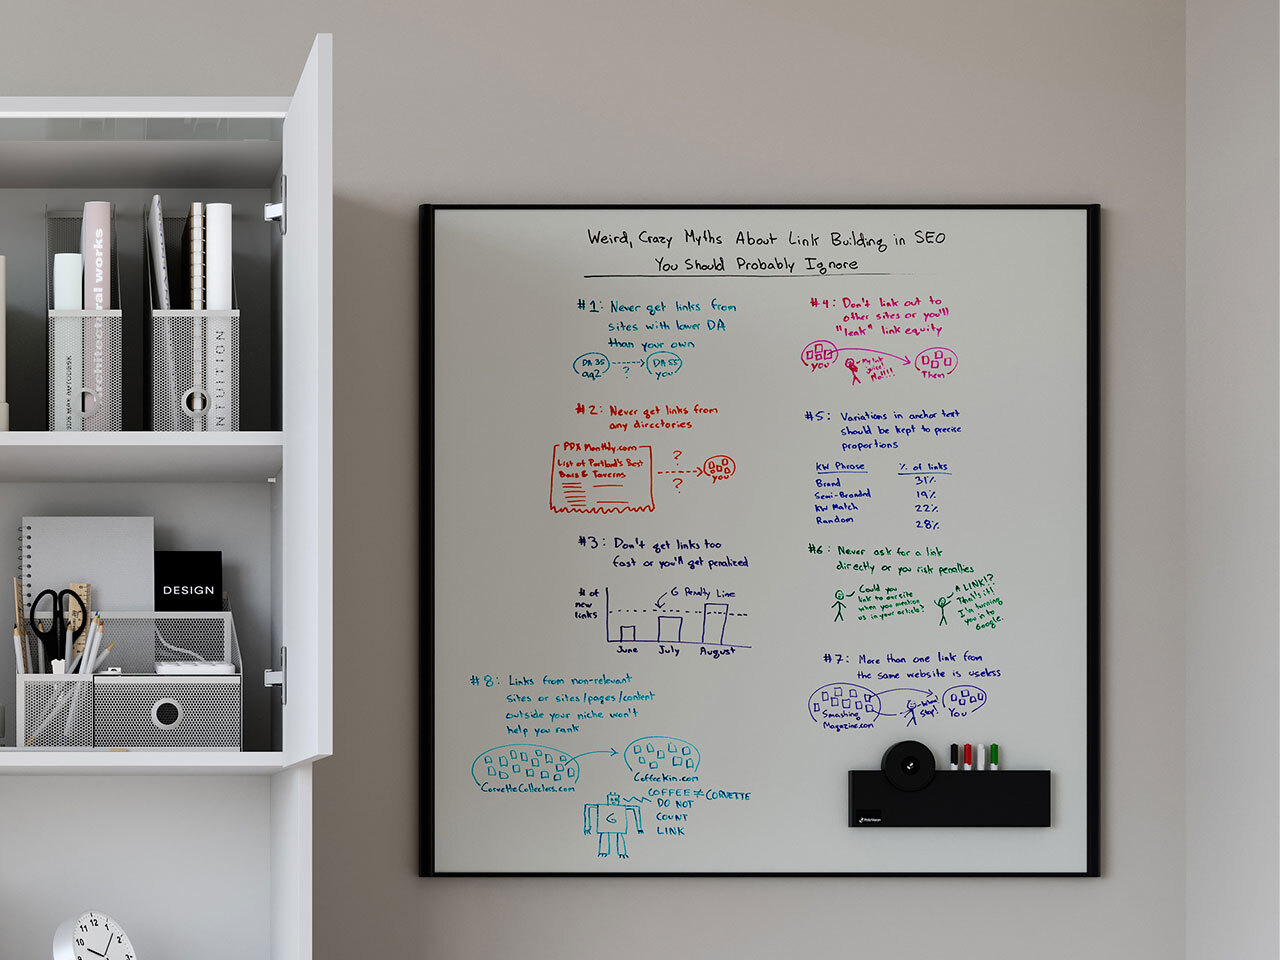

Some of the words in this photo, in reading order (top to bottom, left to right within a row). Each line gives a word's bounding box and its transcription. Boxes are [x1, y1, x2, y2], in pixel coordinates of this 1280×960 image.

[587, 229, 633, 248] Weird,
[639, 231, 672, 248] Crazy
[684, 229, 722, 246] Myths
[736, 231, 777, 245] About
[789, 231, 819, 246] Link
[831, 231, 887, 253] Building
[893, 234, 905, 245] in
[914, 230, 945, 243] SEO
[93, 228, 104, 284] works
[655, 257, 678, 271] You
[685, 257, 725, 271] Should
[736, 257, 795, 273] Probably
[805, 258, 859, 275] Ignore
[611, 300, 641, 312] Never
[646, 301, 666, 316] get
[676, 301, 701, 312] links
[711, 298, 736, 311] from
[842, 297, 870, 308] Don't
[879, 297, 899, 307] link
[904, 297, 921, 306] out
[929, 296, 942, 305] to
[608, 321, 638, 332] sites
[646, 321, 671, 330] with
[676, 320, 700, 330] lower
[707, 319, 726, 331] DA
[881, 325, 900, 334] link
[905, 323, 942, 336] equity
[608, 338, 634, 348] than
[641, 342, 665, 353] your
[609, 405, 638, 416] Never
[643, 406, 660, 419] get
[666, 405, 688, 415] links
[694, 404, 718, 414] from
[840, 412, 887, 421] Variations
[893, 411, 903, 419] in
[909, 409, 937, 420] anchor
[941, 409, 960, 418] text
[609, 423, 628, 432] any
[634, 418, 693, 428] directories
[841, 425, 872, 436] should
[877, 426, 889, 434] be
[895, 425, 915, 436] kept
[842, 439, 898, 452] proportions
[578, 536, 605, 549] #3:
[614, 537, 645, 550] Don't
[653, 540, 670, 553] get
[676, 539, 700, 550] links
[704, 539, 721, 549] too
[838, 546, 866, 555] Never
[874, 547, 892, 556] ask
[896, 547, 911, 556] for
[926, 547, 943, 556] link
[613, 555, 636, 567] fast
[687, 557, 704, 570] get
[836, 560, 875, 574] directly
[898, 567, 912, 576] you
[917, 565, 933, 574] risk
[163, 586, 214, 595] DESIGN
[858, 654, 880, 664] More
[886, 653, 907, 663] than
[938, 652, 956, 663] link
[964, 650, 983, 661] from
[509, 675, 534, 687] Links
[543, 675, 565, 685] from
[571, 672, 632, 685] non-relevant
[506, 709, 544, 719] outside
[549, 712, 570, 722] your
[577, 710, 603, 720] niche
[610, 708, 638, 718] won't
[507, 725, 528, 737] help
[534, 728, 551, 737] you
[555, 724, 579, 733] rank
[76, 938, 84, 946] 10
